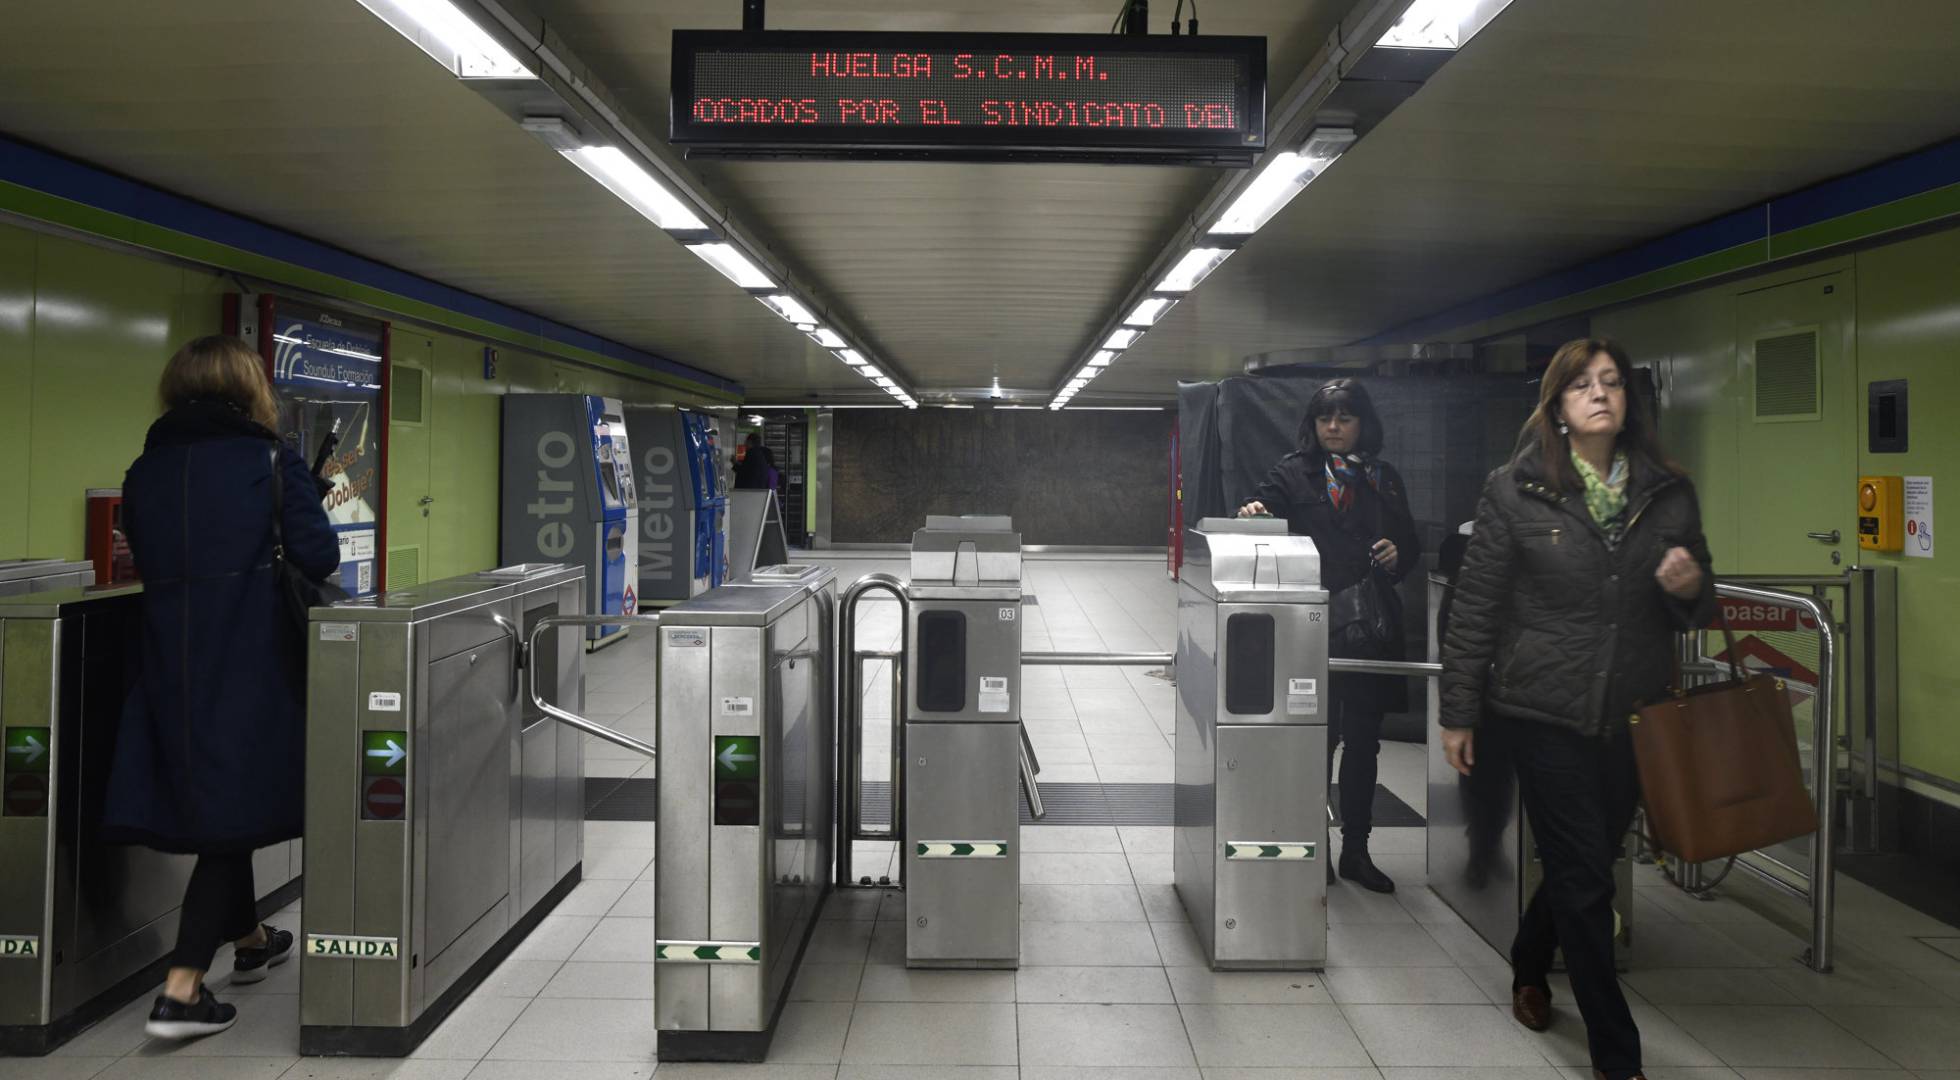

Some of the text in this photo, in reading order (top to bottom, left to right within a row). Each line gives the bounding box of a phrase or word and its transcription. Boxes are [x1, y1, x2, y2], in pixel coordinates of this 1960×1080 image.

[811, 52, 1108, 80] HUELGA S.C.M.M.
[693, 98, 818, 123] OCADOS
[838, 99, 900, 125] POR
[919, 100, 962, 125] EL
[981, 101, 1164, 127] SINDICATO
[303, 360, 373, 384] Soundub Formación
[327, 467, 374, 512] Doblaje?
[527, 430, 575, 558] etro
[638, 446, 674, 580] Metro
[1000, 608, 1013, 620] 03
[1309, 611, 1321, 622] 02
[1724, 604, 1787, 622] pasar
[0, 939, 34, 954] DA
[315, 939, 394, 956] SALIDA
